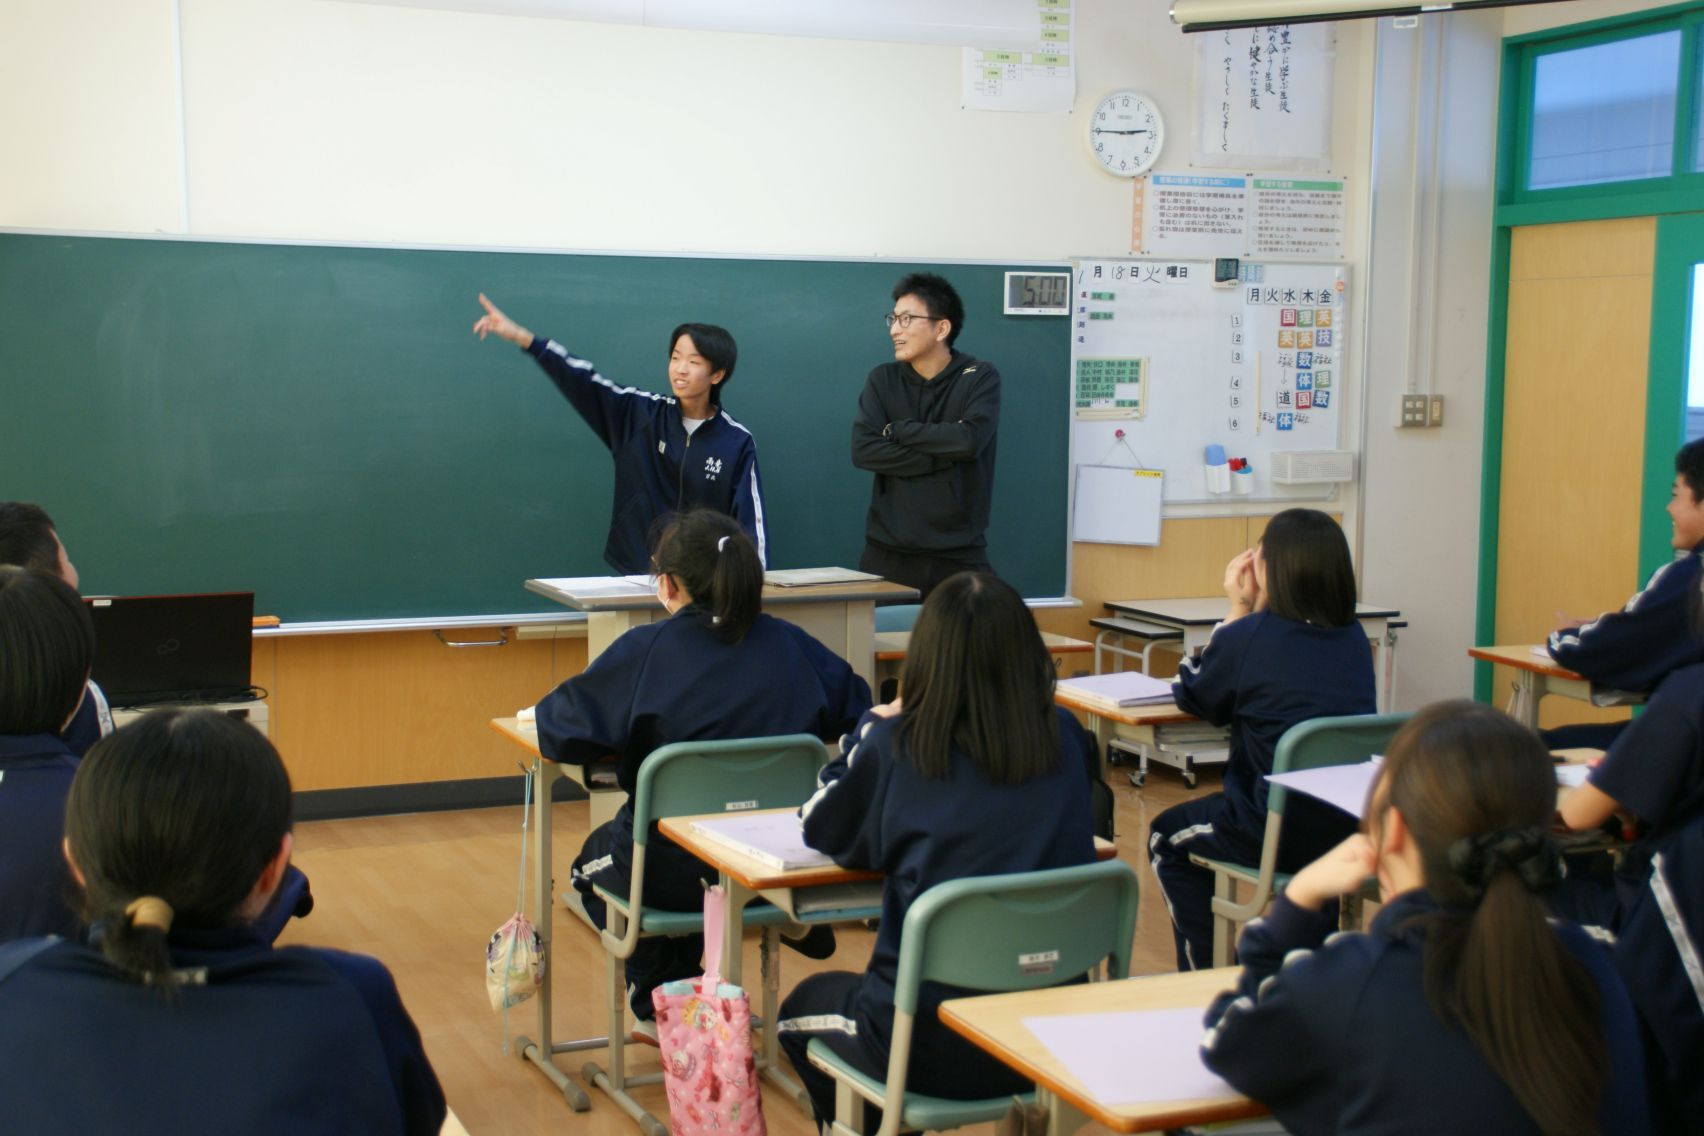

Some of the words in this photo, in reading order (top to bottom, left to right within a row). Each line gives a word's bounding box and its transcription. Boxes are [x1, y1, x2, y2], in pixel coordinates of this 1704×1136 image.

[1122, 99, 1129, 107] 12
[1100, 112, 1106, 121] 10
[1146, 114, 1151, 123] 2
[1251, 288, 1259, 301] 月
[1267, 288, 1278, 302] 火
[1284, 289, 1295, 302] 水
[1302, 290, 1314, 303] 木
[1320, 290, 1332, 303] 金
[1284, 310, 1295, 324] 国
[1317, 330, 1330, 344] 技
[1299, 352, 1311, 367] 数
[1299, 373, 1311, 387] 体
[1279, 390, 1291, 405] 道
[1298, 393, 1310, 406] 国
[1278, 413, 1292, 428] 体
